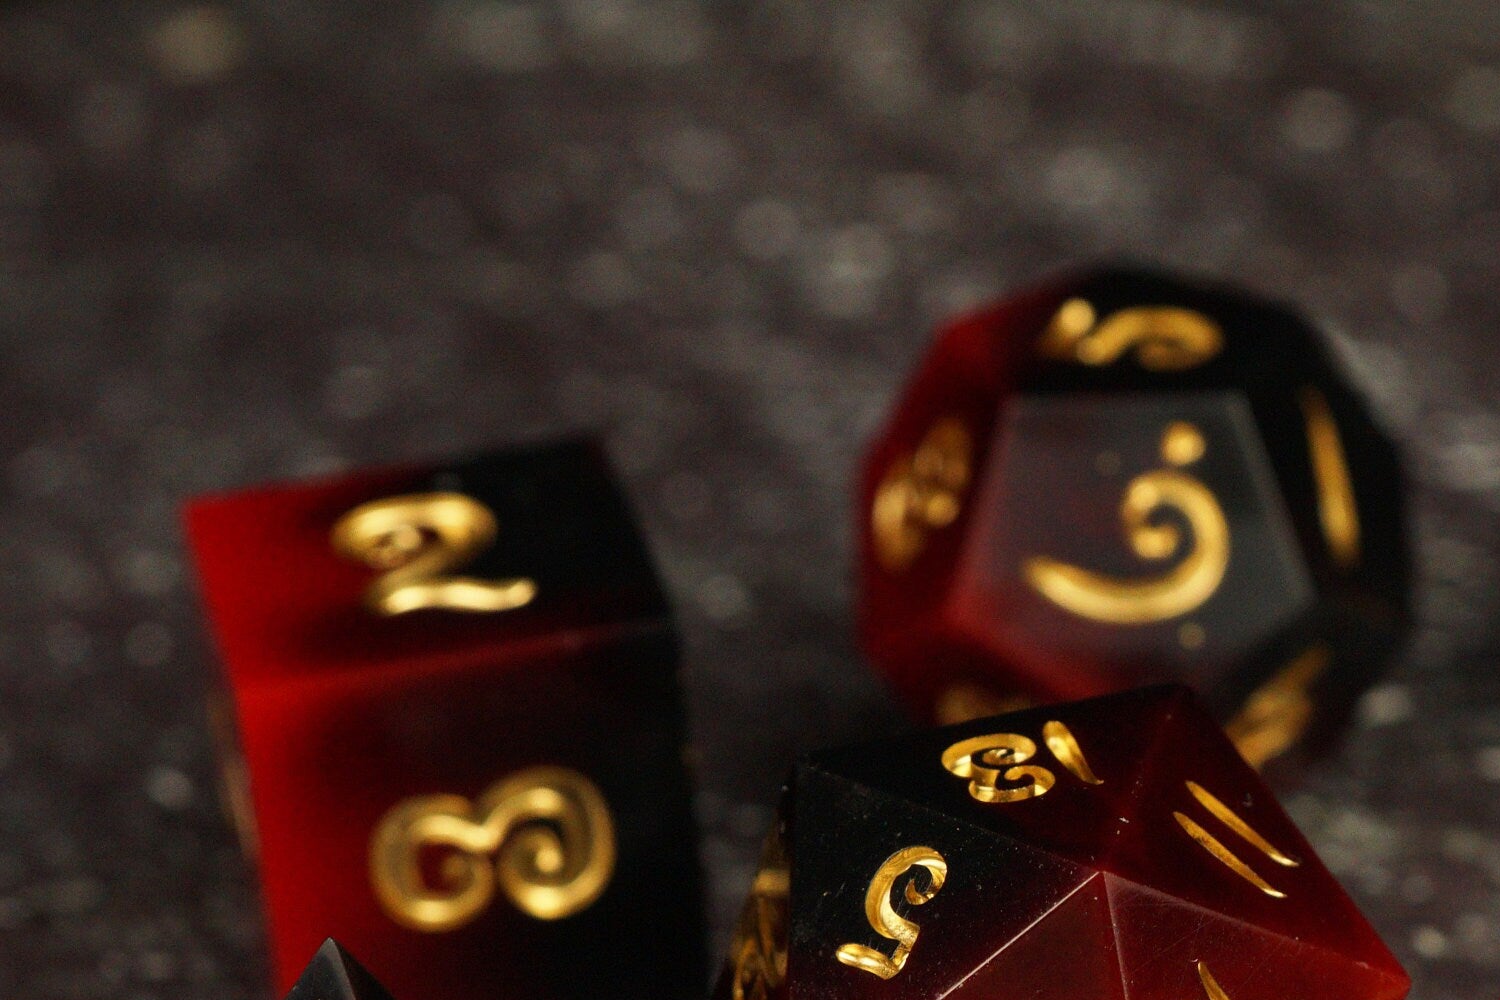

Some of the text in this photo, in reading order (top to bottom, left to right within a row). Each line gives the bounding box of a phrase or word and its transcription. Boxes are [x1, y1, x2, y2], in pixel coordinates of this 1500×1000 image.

[331, 494, 536, 614] 2
[942, 720, 1104, 802] 13
[370, 768, 614, 930] 3
[1174, 780, 1299, 898] 11
[835, 845, 947, 979] 5
